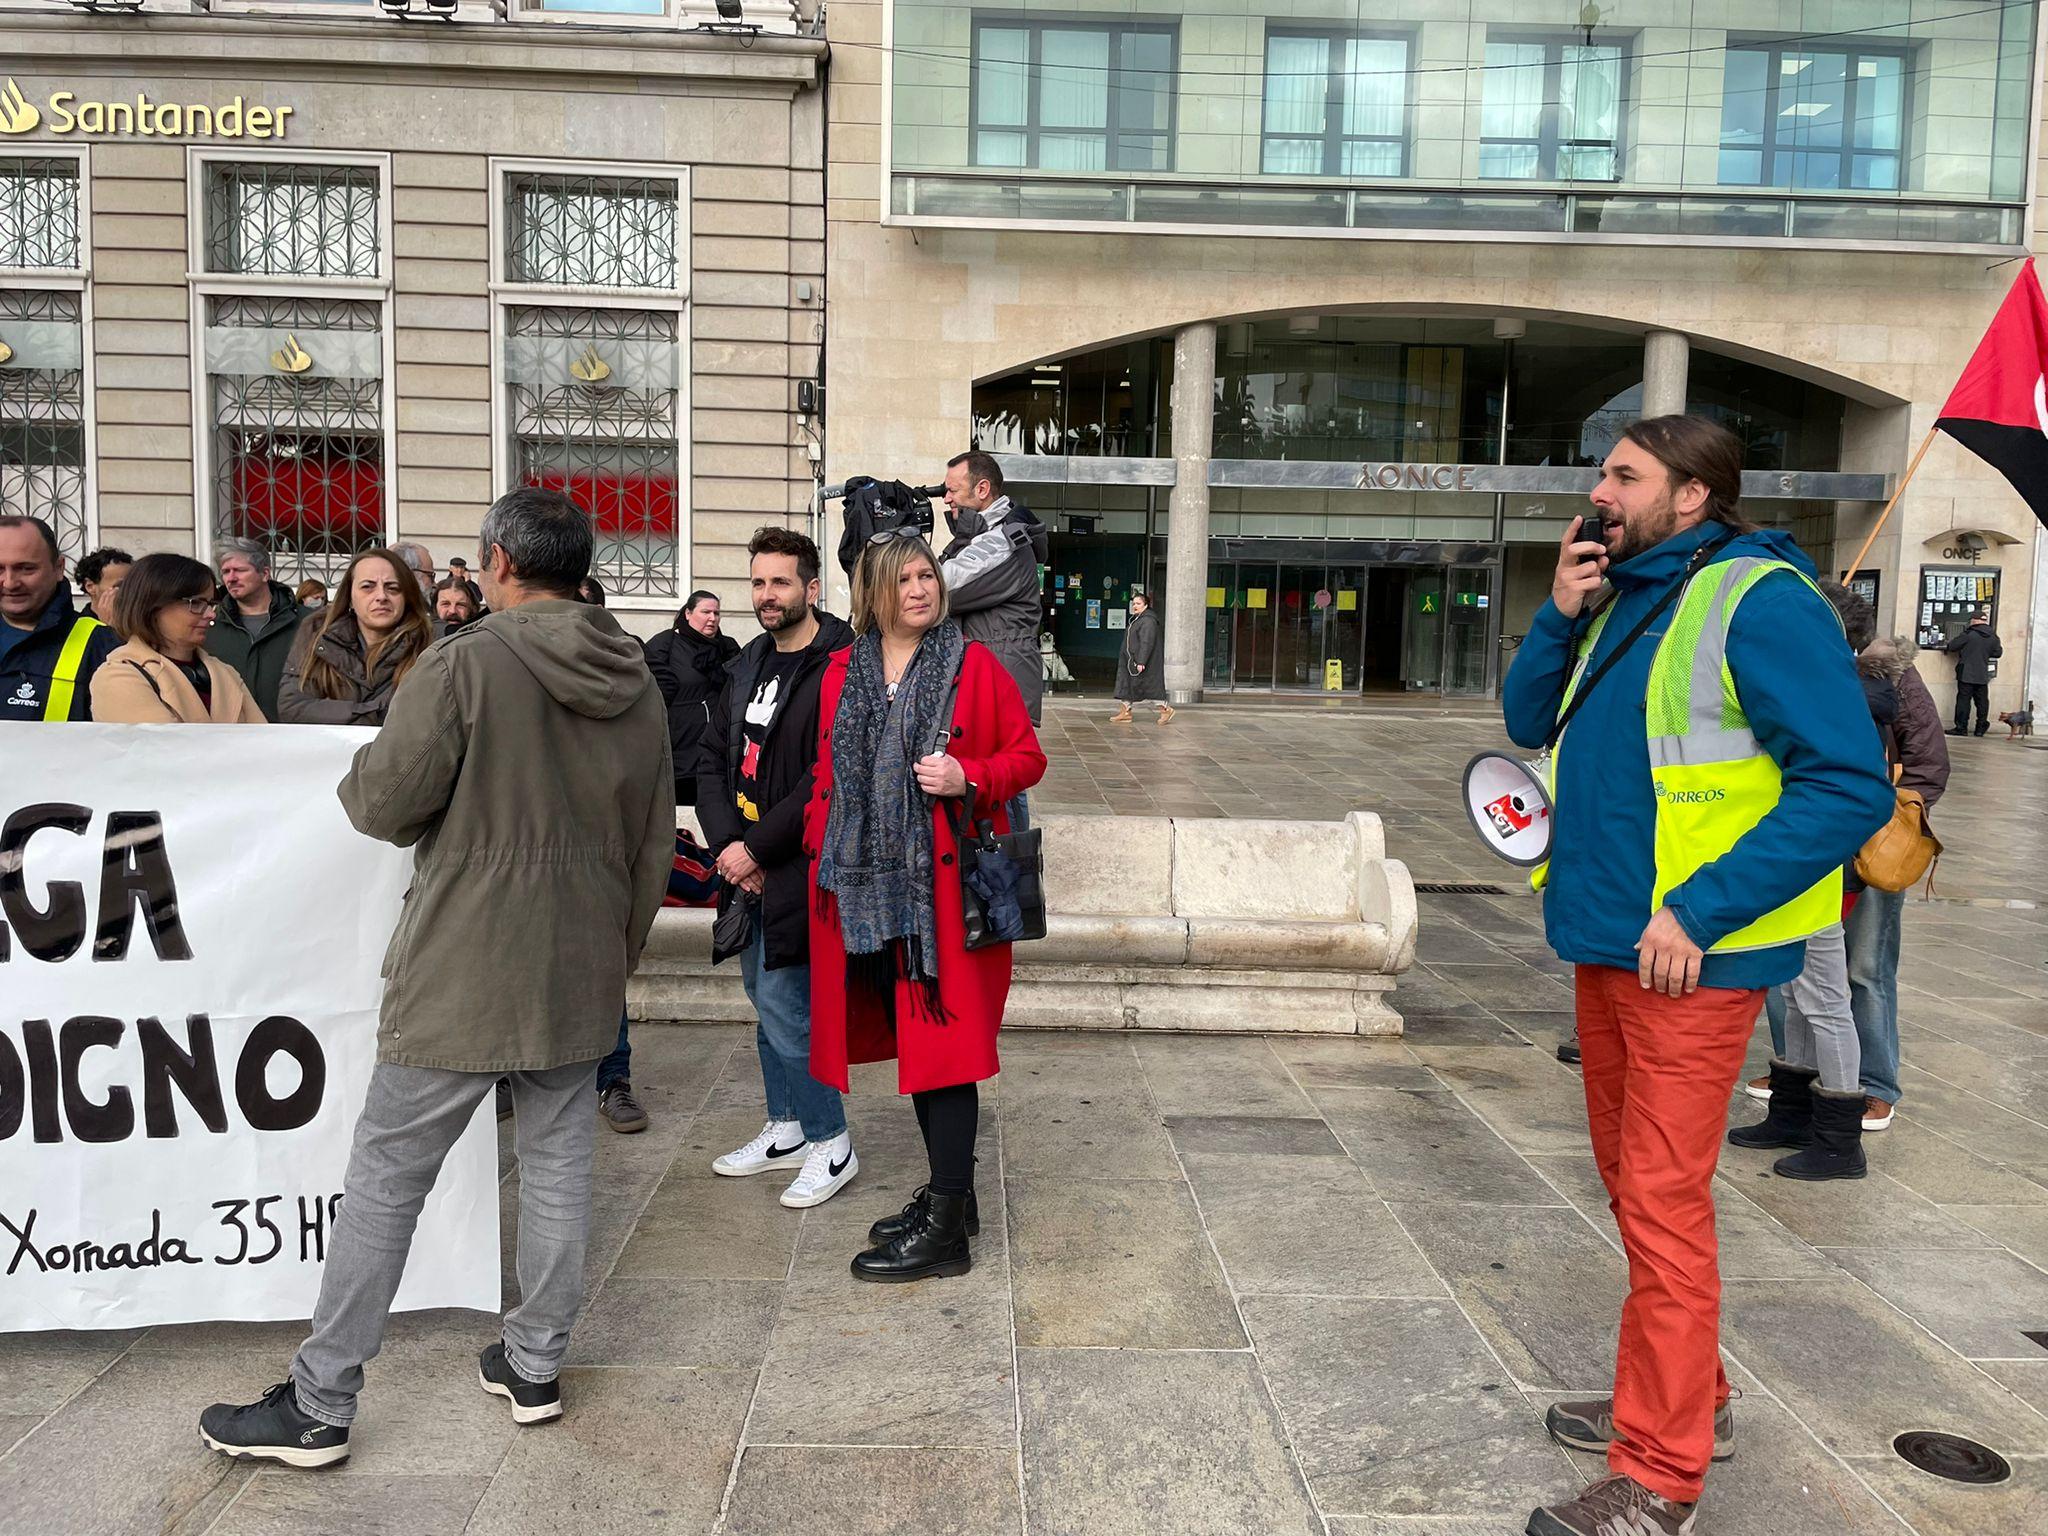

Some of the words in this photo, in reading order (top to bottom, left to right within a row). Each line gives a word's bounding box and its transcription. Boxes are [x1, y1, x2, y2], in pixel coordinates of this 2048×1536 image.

[49, 91, 293, 138] Santander
[1377, 464, 1476, 491] ONCE
[1943, 547, 1982, 560] ONCE
[7, 697, 40, 707] Correos
[1488, 803, 1518, 833] CGT
[0, 802, 195, 963] GA
[0, 1208, 203, 1275] Xornada
[211, 1195, 283, 1265] 35
